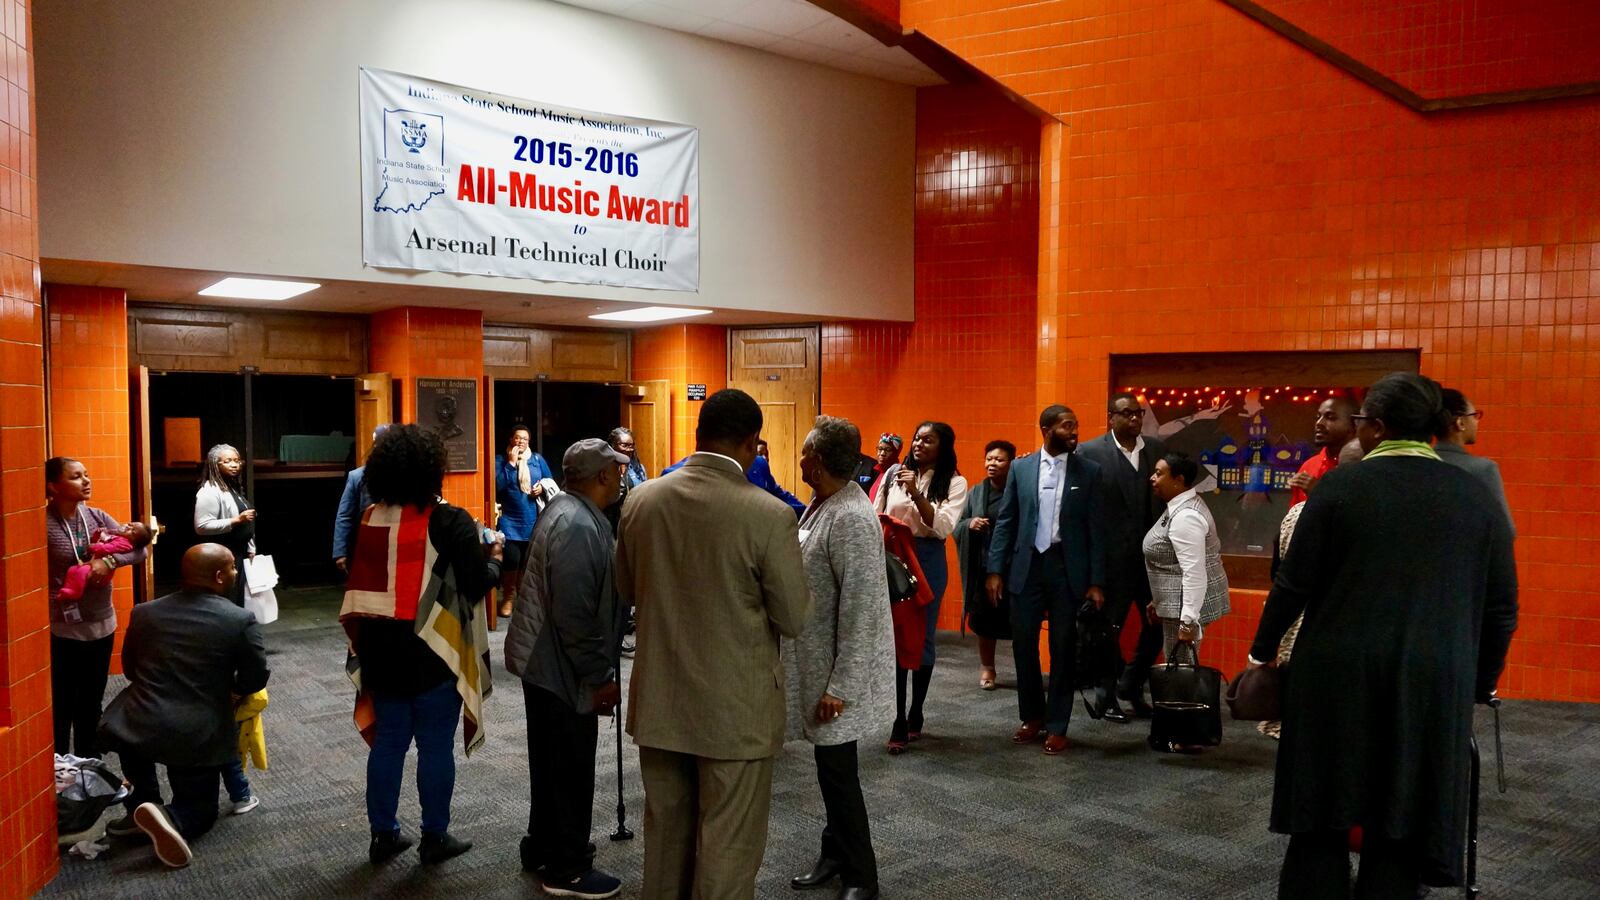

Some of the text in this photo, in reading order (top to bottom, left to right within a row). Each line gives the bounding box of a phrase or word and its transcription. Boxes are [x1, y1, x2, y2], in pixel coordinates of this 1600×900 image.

[462, 95, 494, 110] State
[497, 101, 537, 118] School
[541, 108, 575, 124] Music
[578, 116, 643, 136] Association,
[646, 126, 667, 139] Inc.
[401, 127, 428, 138] ISSMA
[376, 157, 451, 174] Indiana State School
[514, 135, 639, 178] 2015-2016
[382, 174, 448, 189] Music Association
[457, 163, 689, 229] All-Music Award
[573, 223, 587, 236] to
[405, 227, 667, 272] Arsenal Technical Choir
